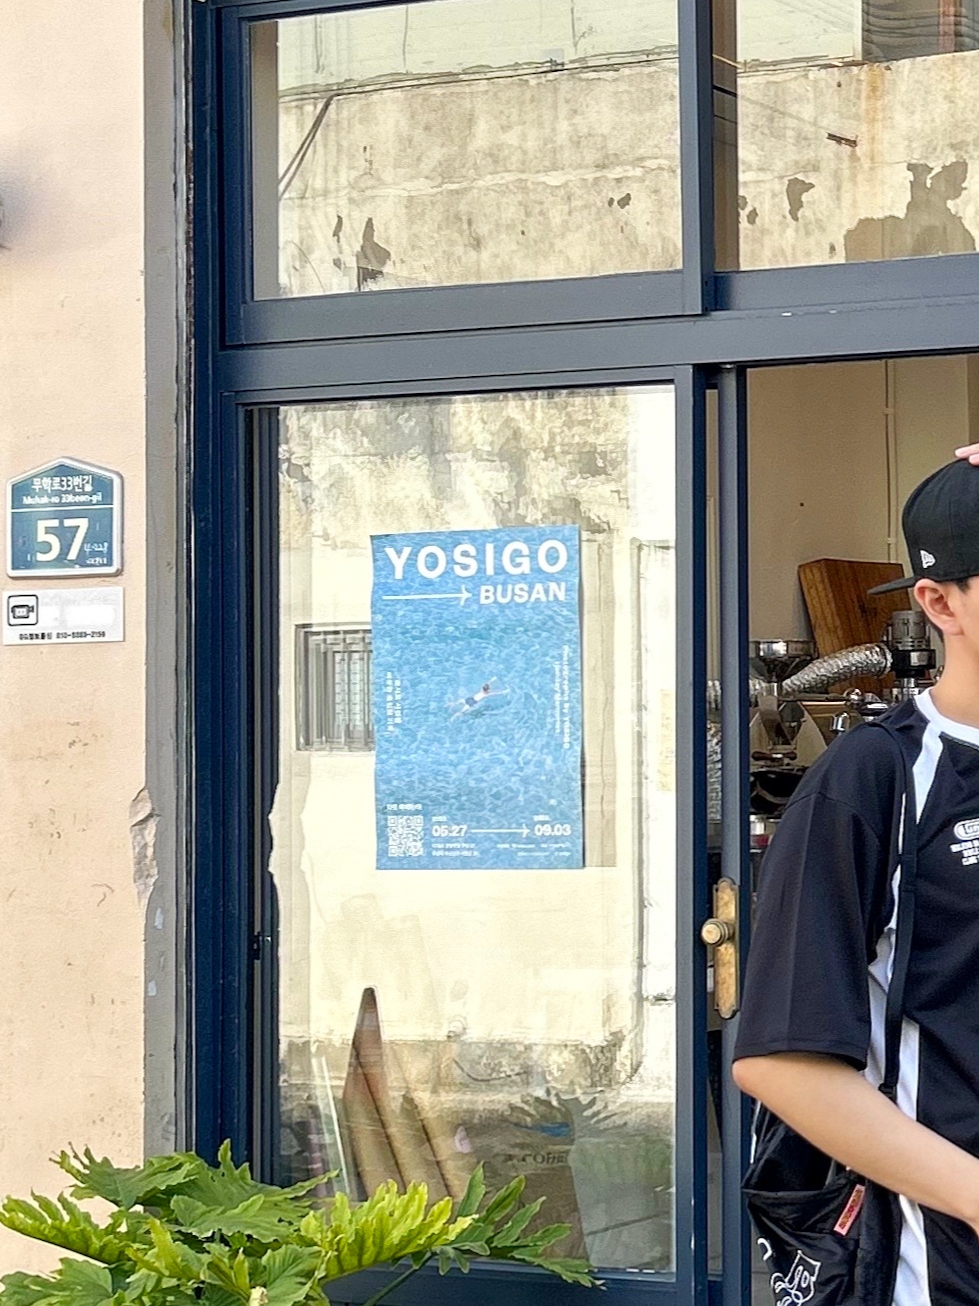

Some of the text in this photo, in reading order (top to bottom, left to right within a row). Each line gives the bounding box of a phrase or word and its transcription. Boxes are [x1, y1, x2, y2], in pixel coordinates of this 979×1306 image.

[36, 517, 89, 562] 57
[384, 539, 568, 580] YOSIGO
[479, 582, 566, 605] BUSAN
[431, 825, 468, 837] 05.27
[534, 824, 572, 836] 09.03
